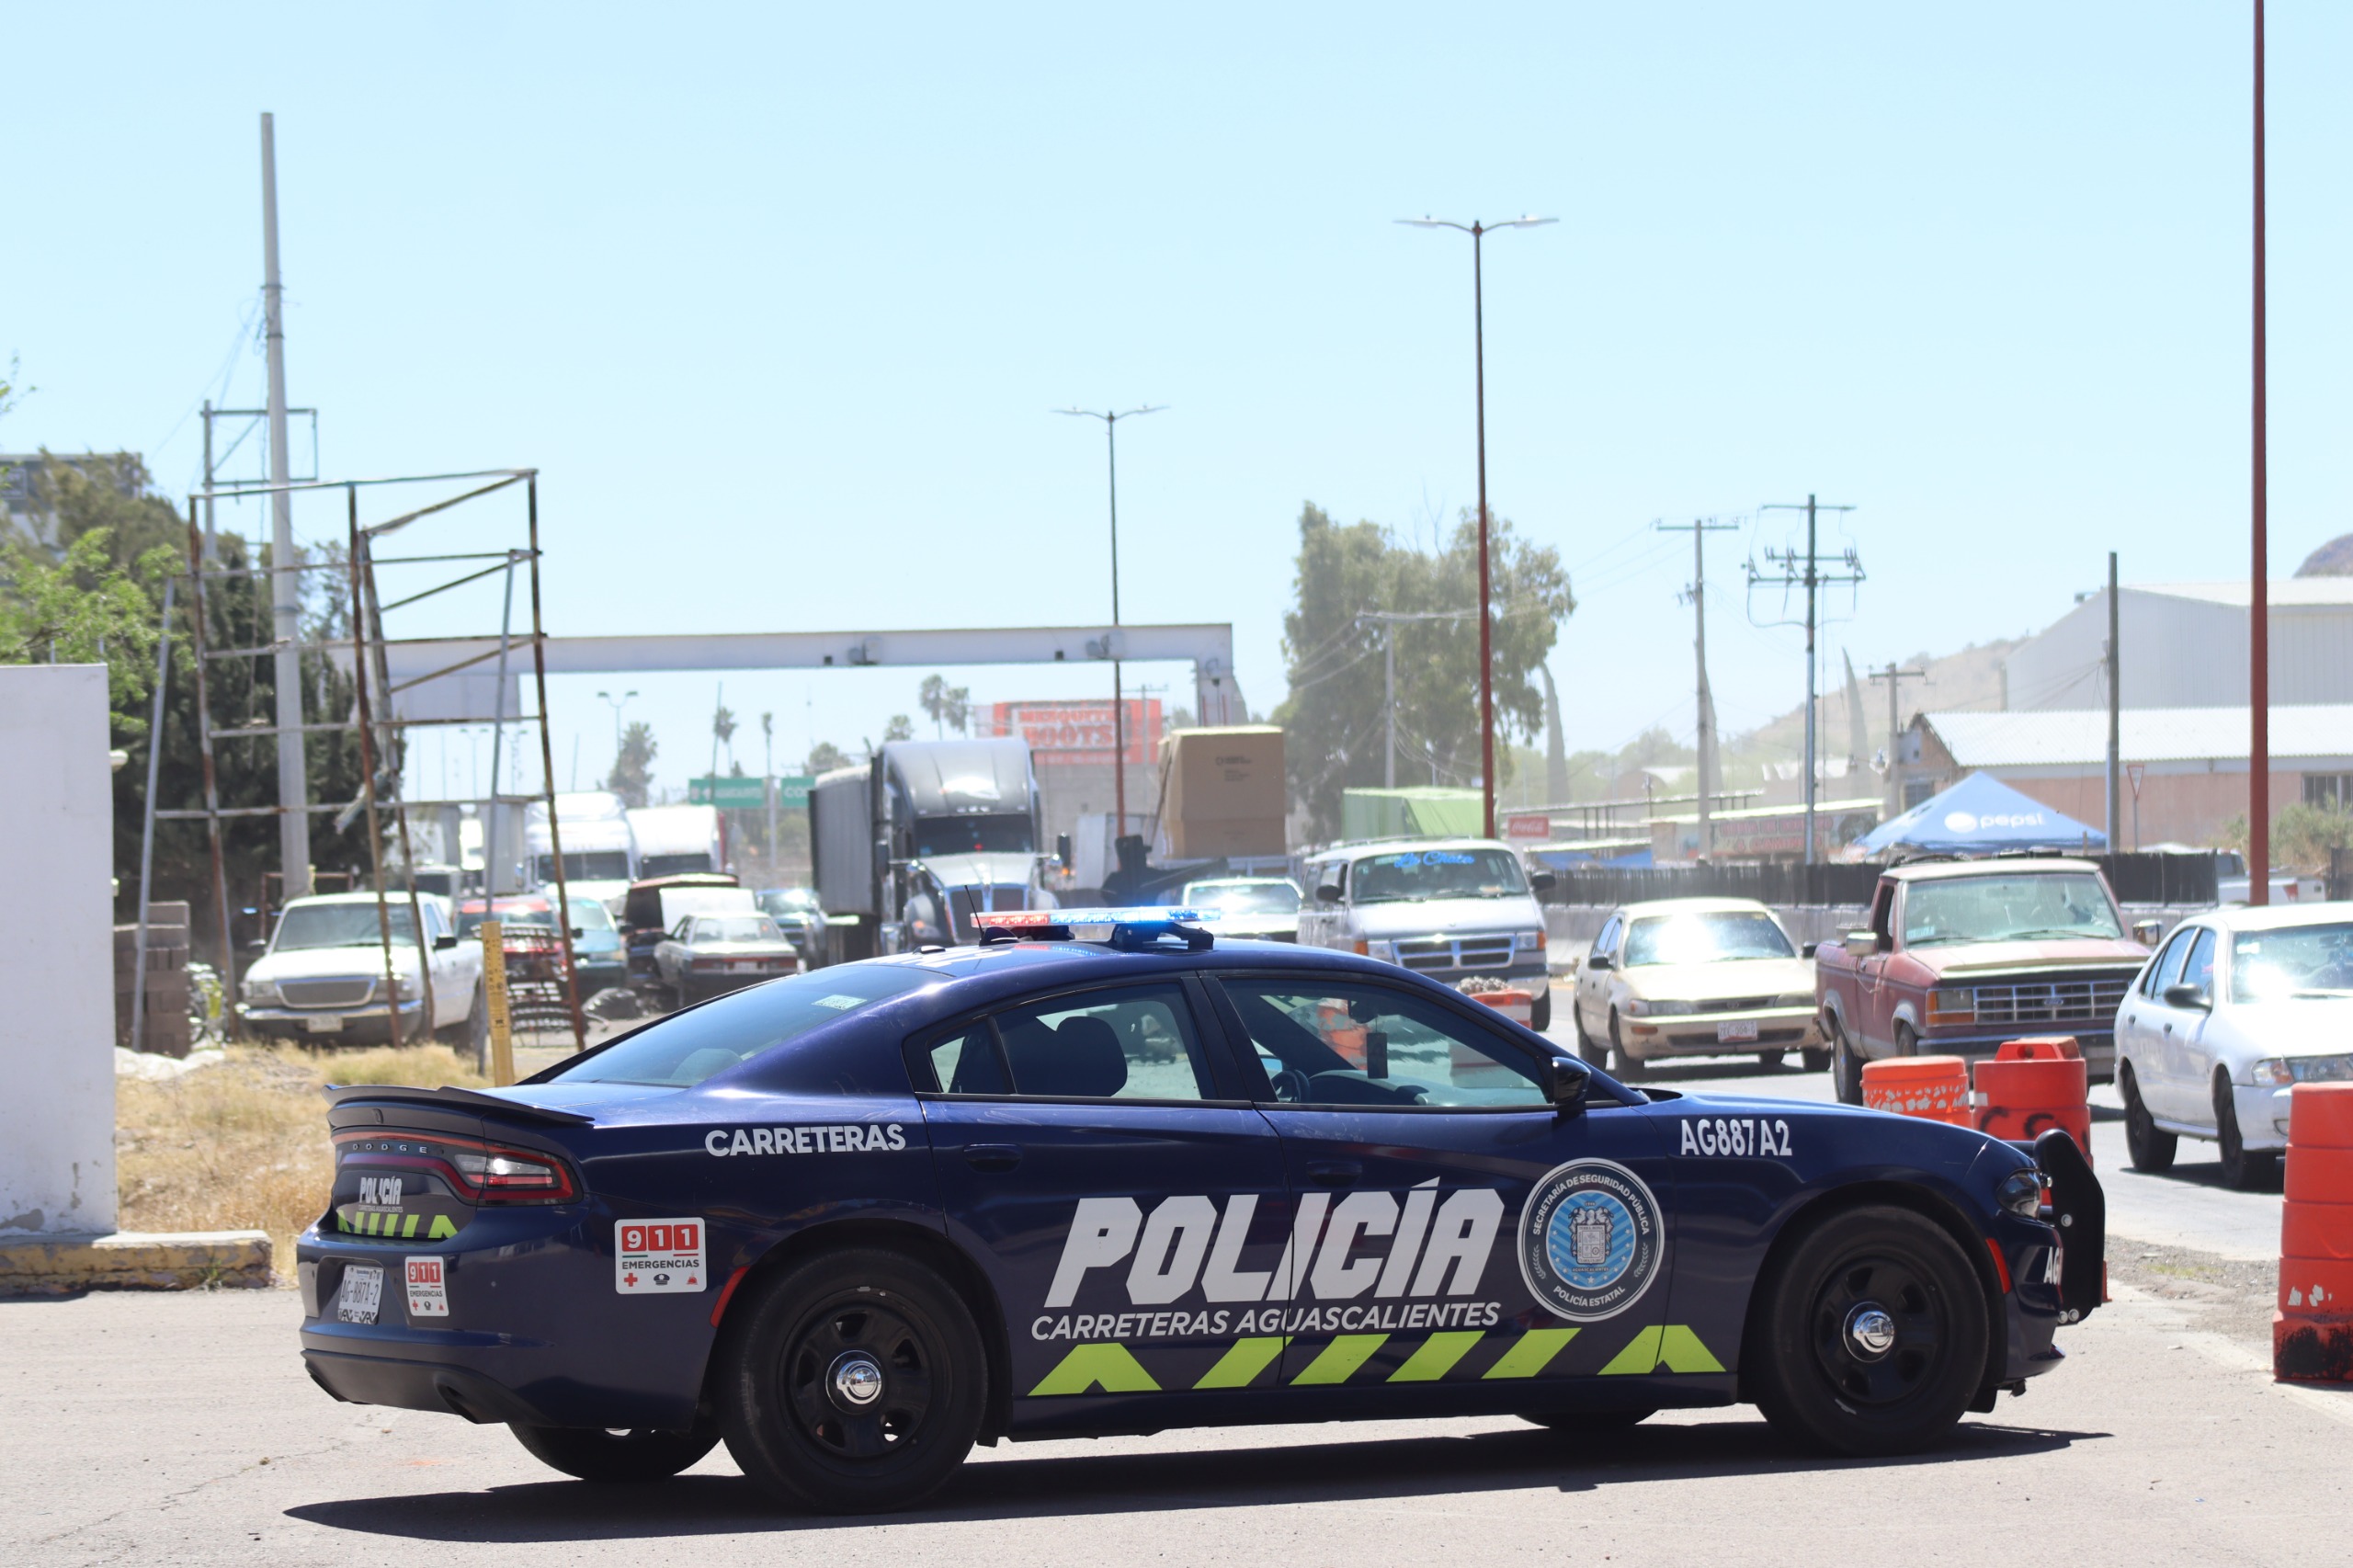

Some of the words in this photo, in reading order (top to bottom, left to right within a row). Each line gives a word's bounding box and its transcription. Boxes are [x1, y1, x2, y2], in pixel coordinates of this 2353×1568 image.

[352, 1143, 427, 1154] DODGE
[705, 1124, 906, 1157] CARRETERAS
[358, 1176, 403, 1206] POLICÍA
[1533, 1181, 1567, 1235] SECRETARÍA
[1565, 1176, 1580, 1187] DE
[1579, 1174, 1631, 1198] SEGURIDAD
[1628, 1194, 1651, 1235] PÚBLICA
[625, 1227, 693, 1249] 911
[1043, 1176, 1506, 1308] POLICÍA
[409, 1264, 439, 1281] 911
[622, 1259, 699, 1269] EMERGENCIAS
[409, 1290, 443, 1298] EMERGENCIAS
[1553, 1285, 1588, 1307] POLICÍA
[1588, 1286, 1626, 1307] ESTATAL
[1031, 1310, 1231, 1341] CARRETERAS
[1233, 1301, 1502, 1334] AGUASCALIENTES
